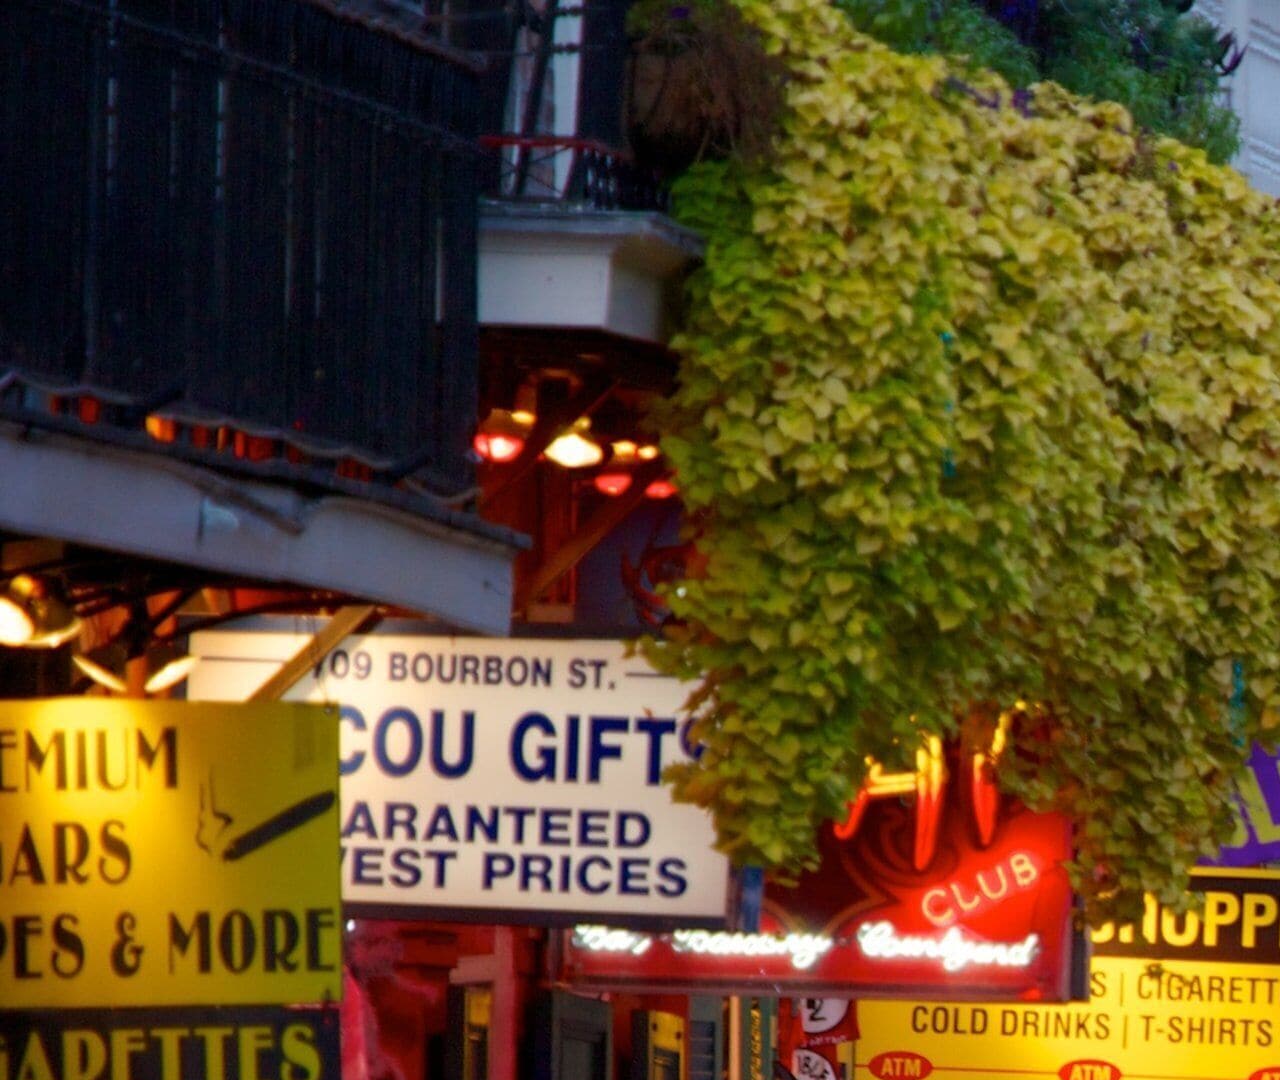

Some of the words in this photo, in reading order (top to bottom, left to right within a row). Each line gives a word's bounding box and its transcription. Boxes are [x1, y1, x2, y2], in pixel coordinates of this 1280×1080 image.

[388, 652, 552, 687] BOURBON
[568, 657, 616, 690] ST.
[0, 819, 132, 886] ARS
[341, 847, 458, 889] EST
[482, 852, 690, 898] PRICES
[921, 853, 1040, 926] CLUB
[0, 912, 85, 980] ES
[110, 911, 145, 978] &
[168, 907, 335, 976] MORE
[911, 1006, 988, 1036] COLD
[1000, 1009, 1111, 1040] DRINKS
[1141, 1016, 1273, 1048] T-SHIRTS
[881, 1057, 922, 1079] ATM
